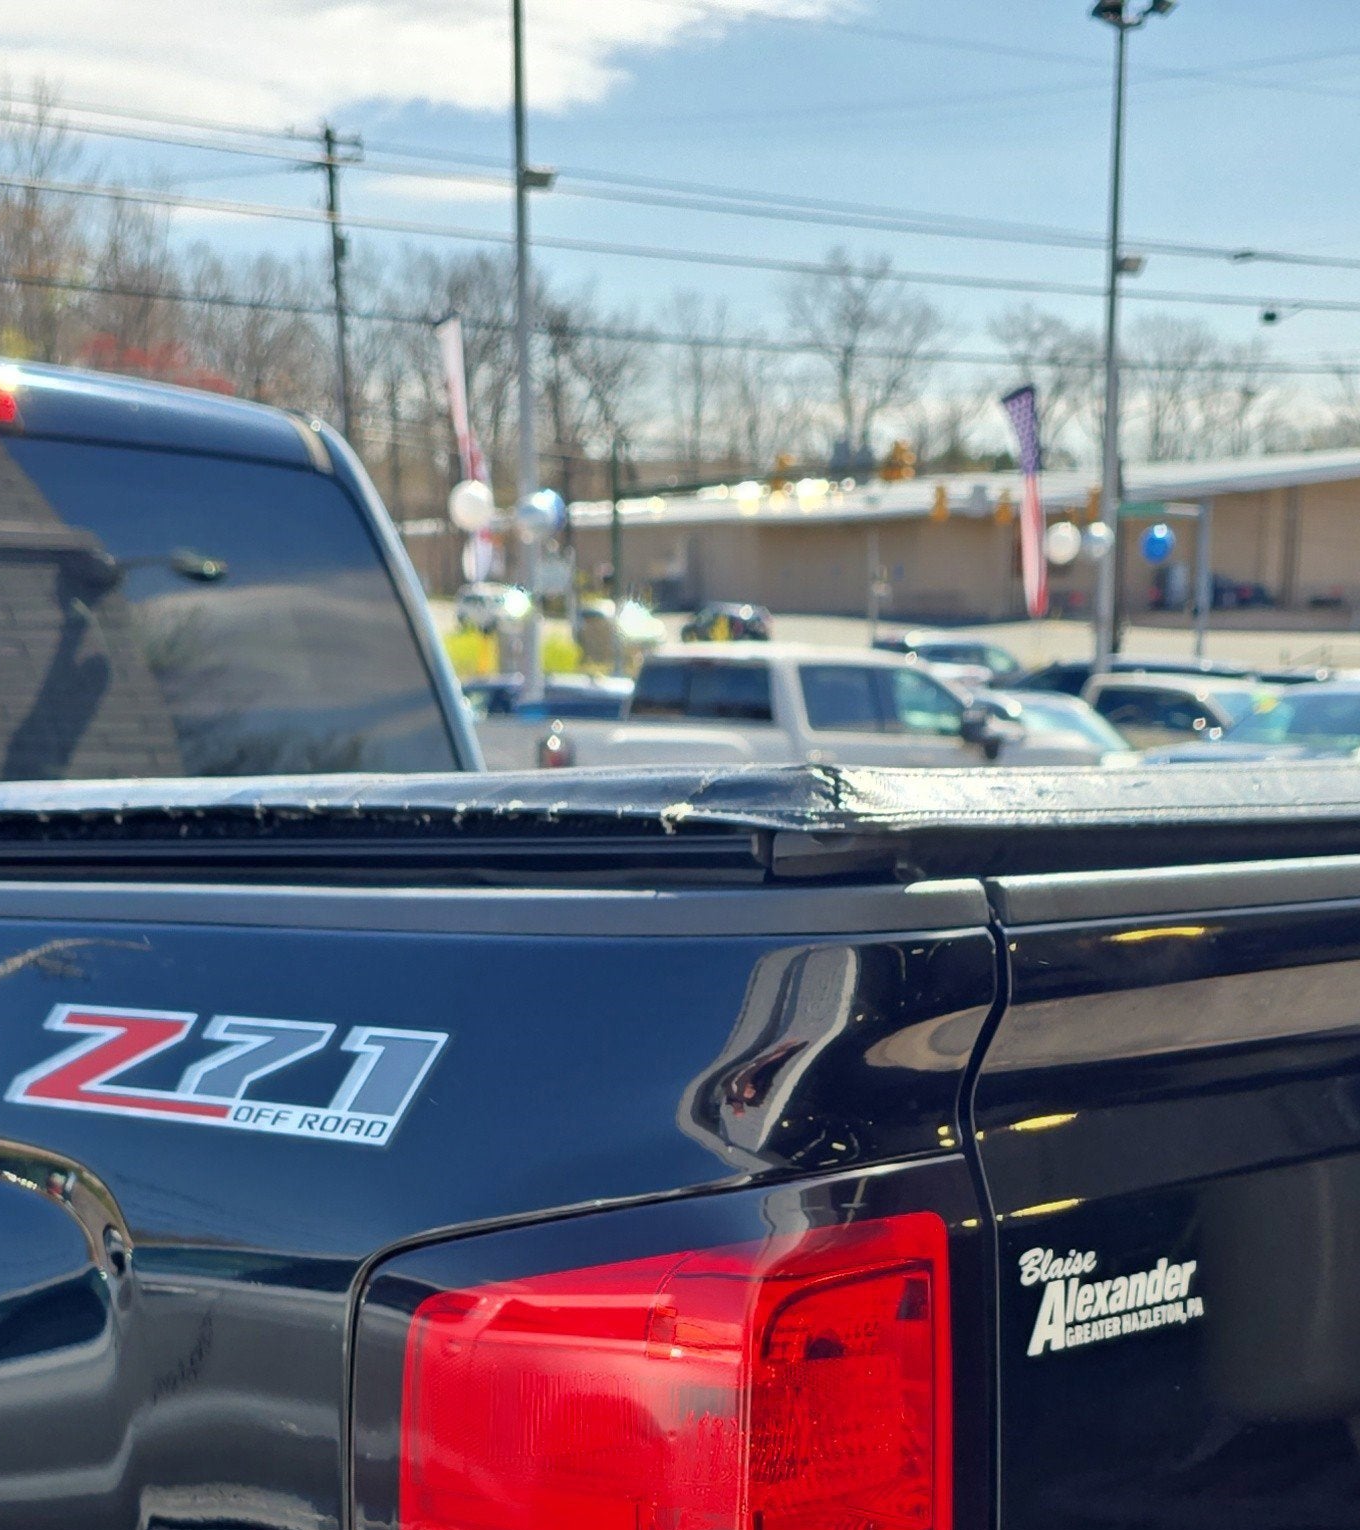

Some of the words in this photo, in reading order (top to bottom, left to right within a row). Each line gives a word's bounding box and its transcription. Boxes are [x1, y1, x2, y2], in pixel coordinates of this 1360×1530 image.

[4, 1003, 450, 1143] Z71
[232, 1105, 292, 1127] OFF
[297, 1112, 388, 1139] ROAD
[1018, 1247, 1097, 1287] Blaise
[1027, 1257, 1197, 1357] Alexander
[1065, 1317, 1122, 1348] GREATER
[1186, 1297, 1204, 1319] PA
